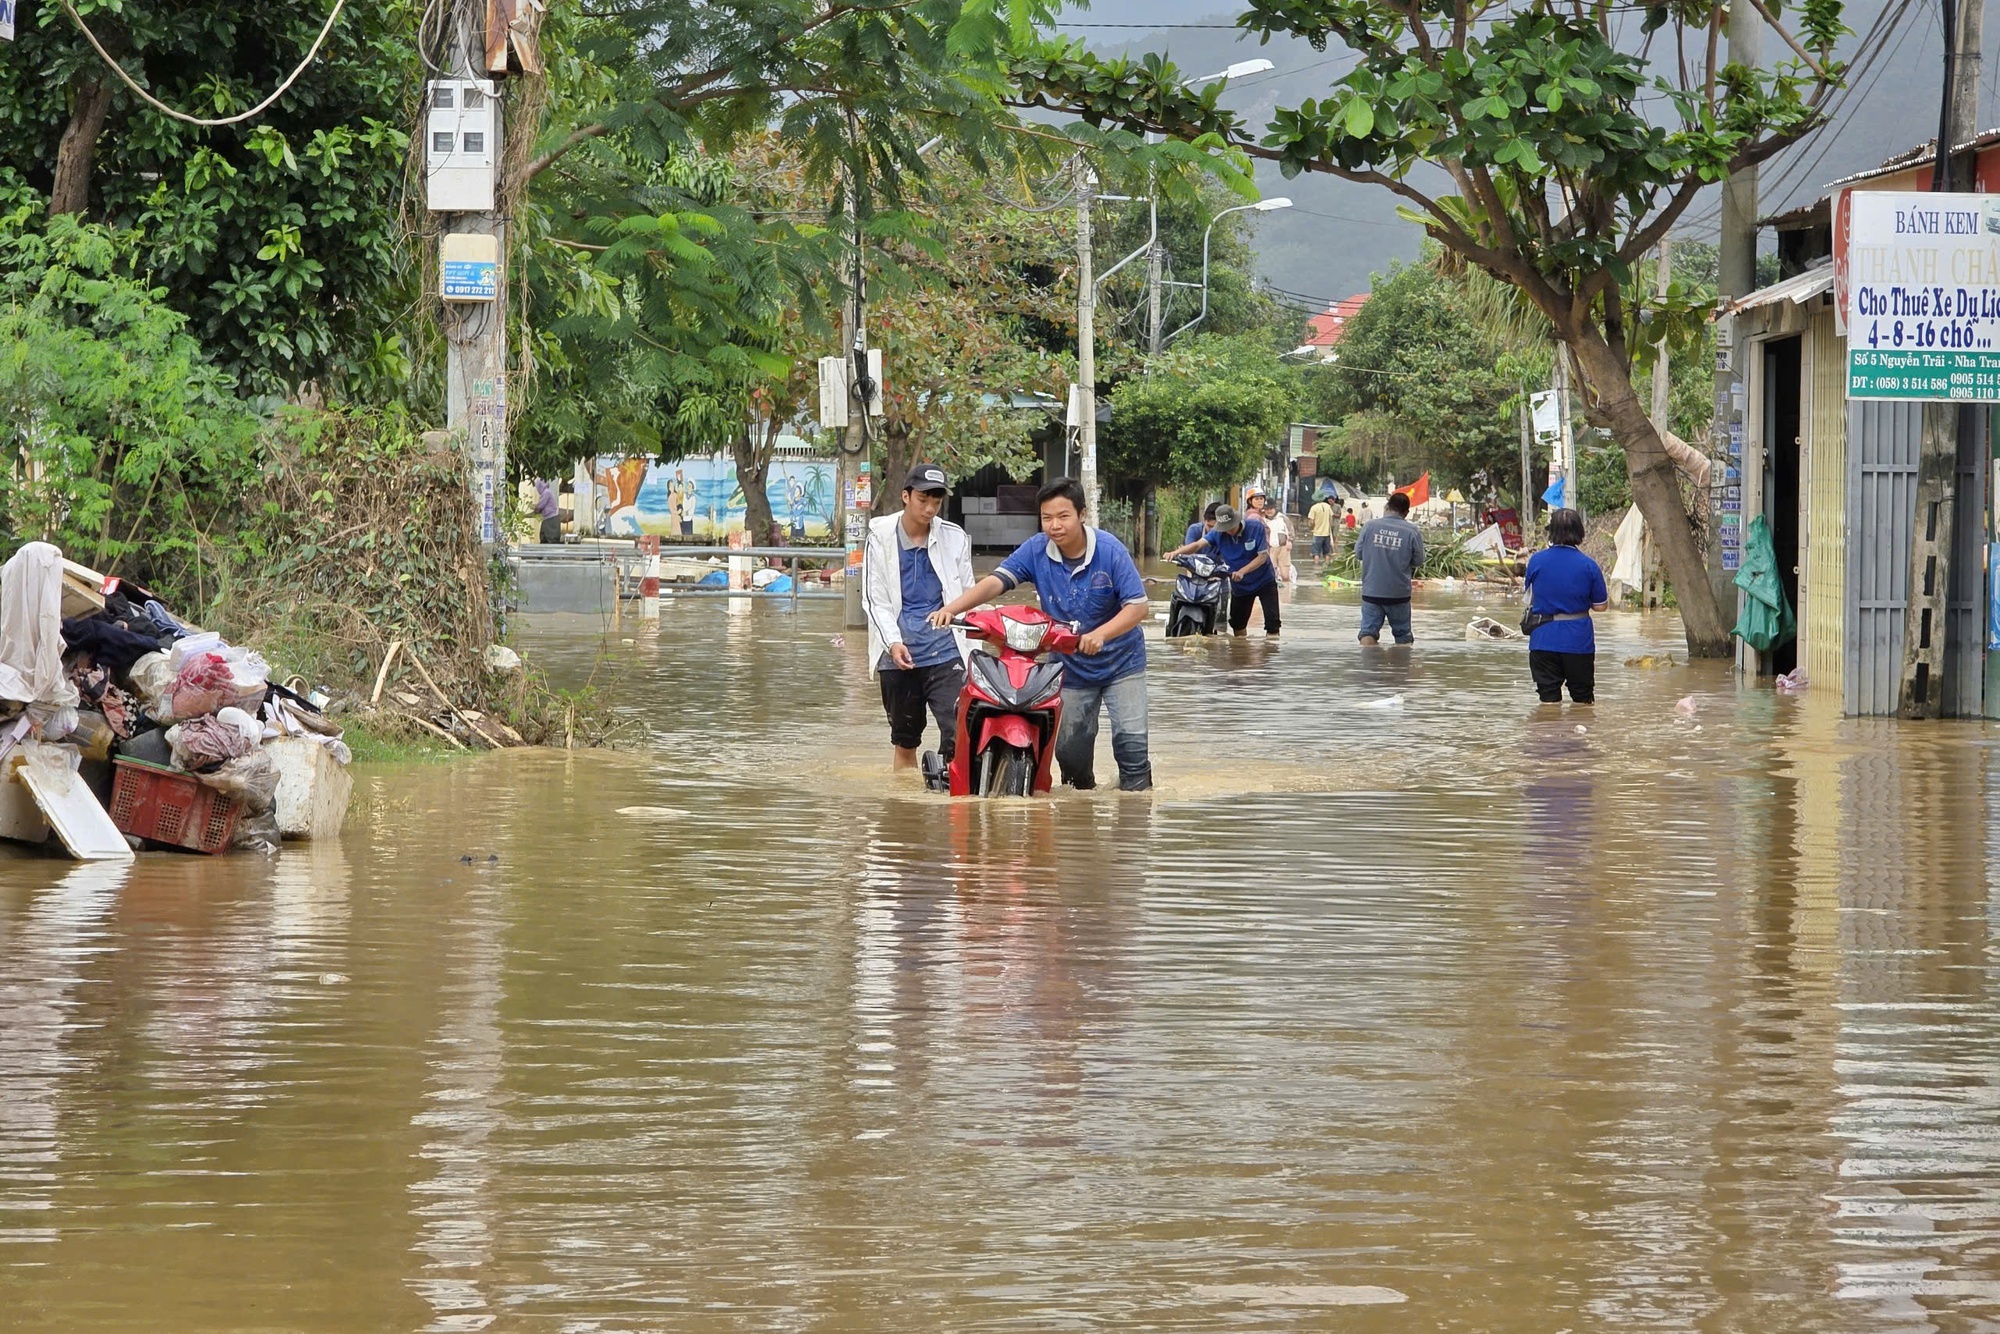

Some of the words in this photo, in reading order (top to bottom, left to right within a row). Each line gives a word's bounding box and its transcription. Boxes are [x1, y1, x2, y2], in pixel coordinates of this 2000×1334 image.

[1896, 205, 1939, 234] BÁNH
[1944, 212, 1979, 234] KEM
[1856, 246, 1938, 284] THANH
[455, 285, 471, 294] 0917
[471, 286, 483, 294] 272
[483, 286, 495, 295] 211
[1859, 286, 1887, 316] Cho
[1891, 287, 1929, 316] Thuê
[1932, 288, 1952, 317] Xe
[1854, 351, 1869, 366] Số
[1870, 353, 1877, 366] 5
[1879, 352, 1920, 369] Nguyễn
[1922, 354, 1945, 367] Trãi
[1954, 355, 1976, 368] Nha
[1876, 376, 1900, 390] (058)
[1902, 377, 1909, 389] 3
[1911, 377, 1928, 390] 514
[1930, 378, 1948, 390] 586
[1950, 373, 1974, 385] 0905
[1976, 373, 1994, 385] 514
[1950, 387, 1974, 399] 0905
[1976, 387, 1994, 399] 110
[1373, 534, 1403, 547] HTH
